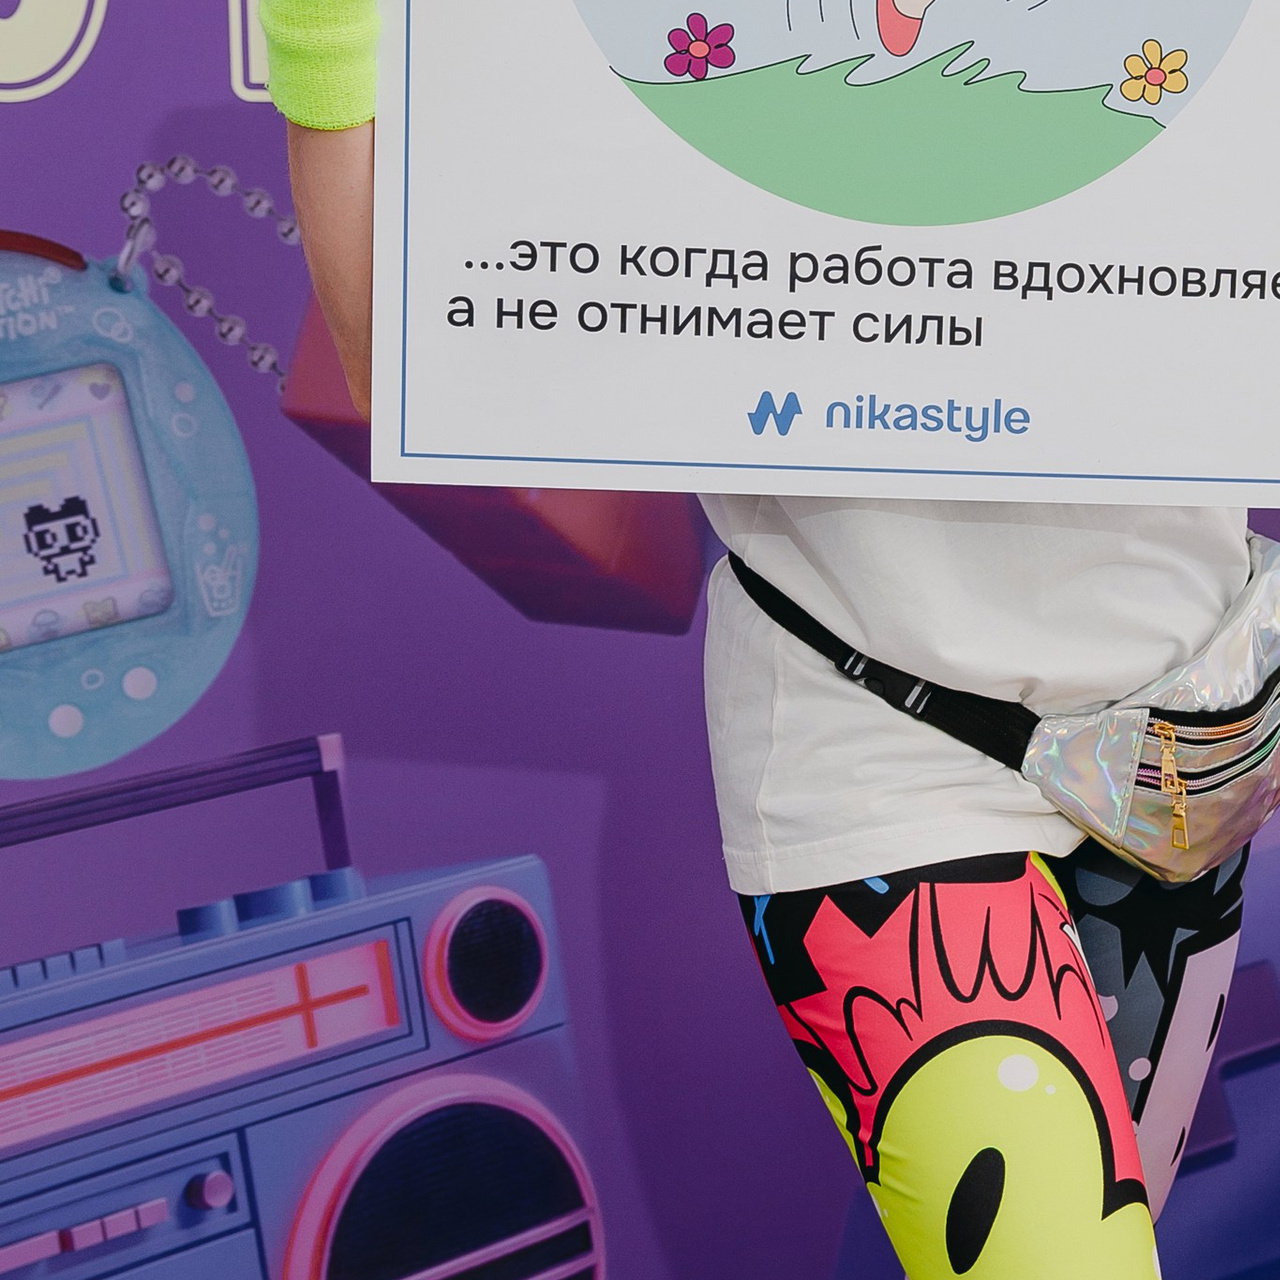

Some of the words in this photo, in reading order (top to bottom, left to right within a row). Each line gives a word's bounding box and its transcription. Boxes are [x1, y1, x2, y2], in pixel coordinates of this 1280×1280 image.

[464, 239, 600, 274] ...это
[619, 243, 768, 288] когда
[788, 245, 974, 293] работа
[446, 294, 475, 328] а
[496, 297, 559, 331] не
[577, 299, 836, 341] отнимает
[852, 311, 984, 347] силы
[825, 394, 1031, 443] nikastyle
